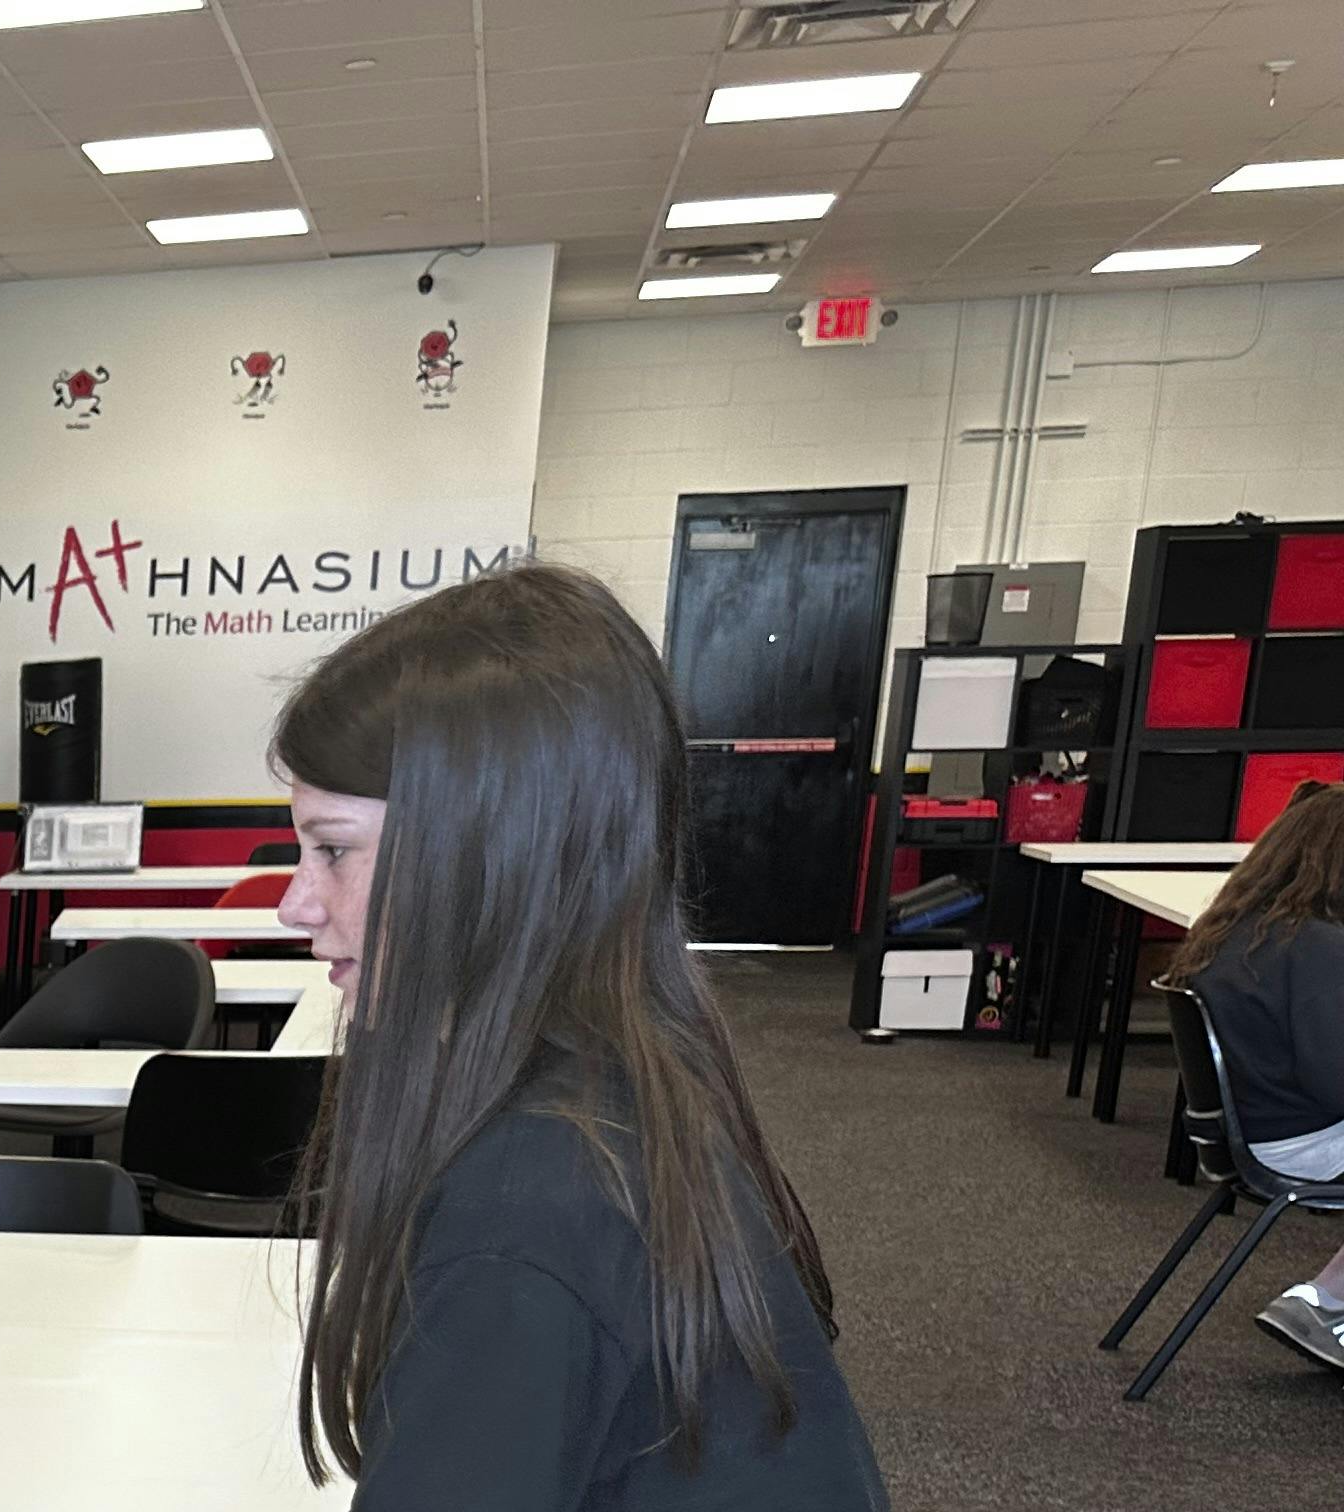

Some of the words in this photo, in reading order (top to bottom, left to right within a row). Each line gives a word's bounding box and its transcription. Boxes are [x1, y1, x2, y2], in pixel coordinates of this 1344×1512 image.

[817, 298, 872, 340] EXIT
[147, 612, 197, 636] The
[203, 609, 273, 635] Math
[282, 606, 390, 633] Learnin
[24, 694, 77, 729] EVERLAST
